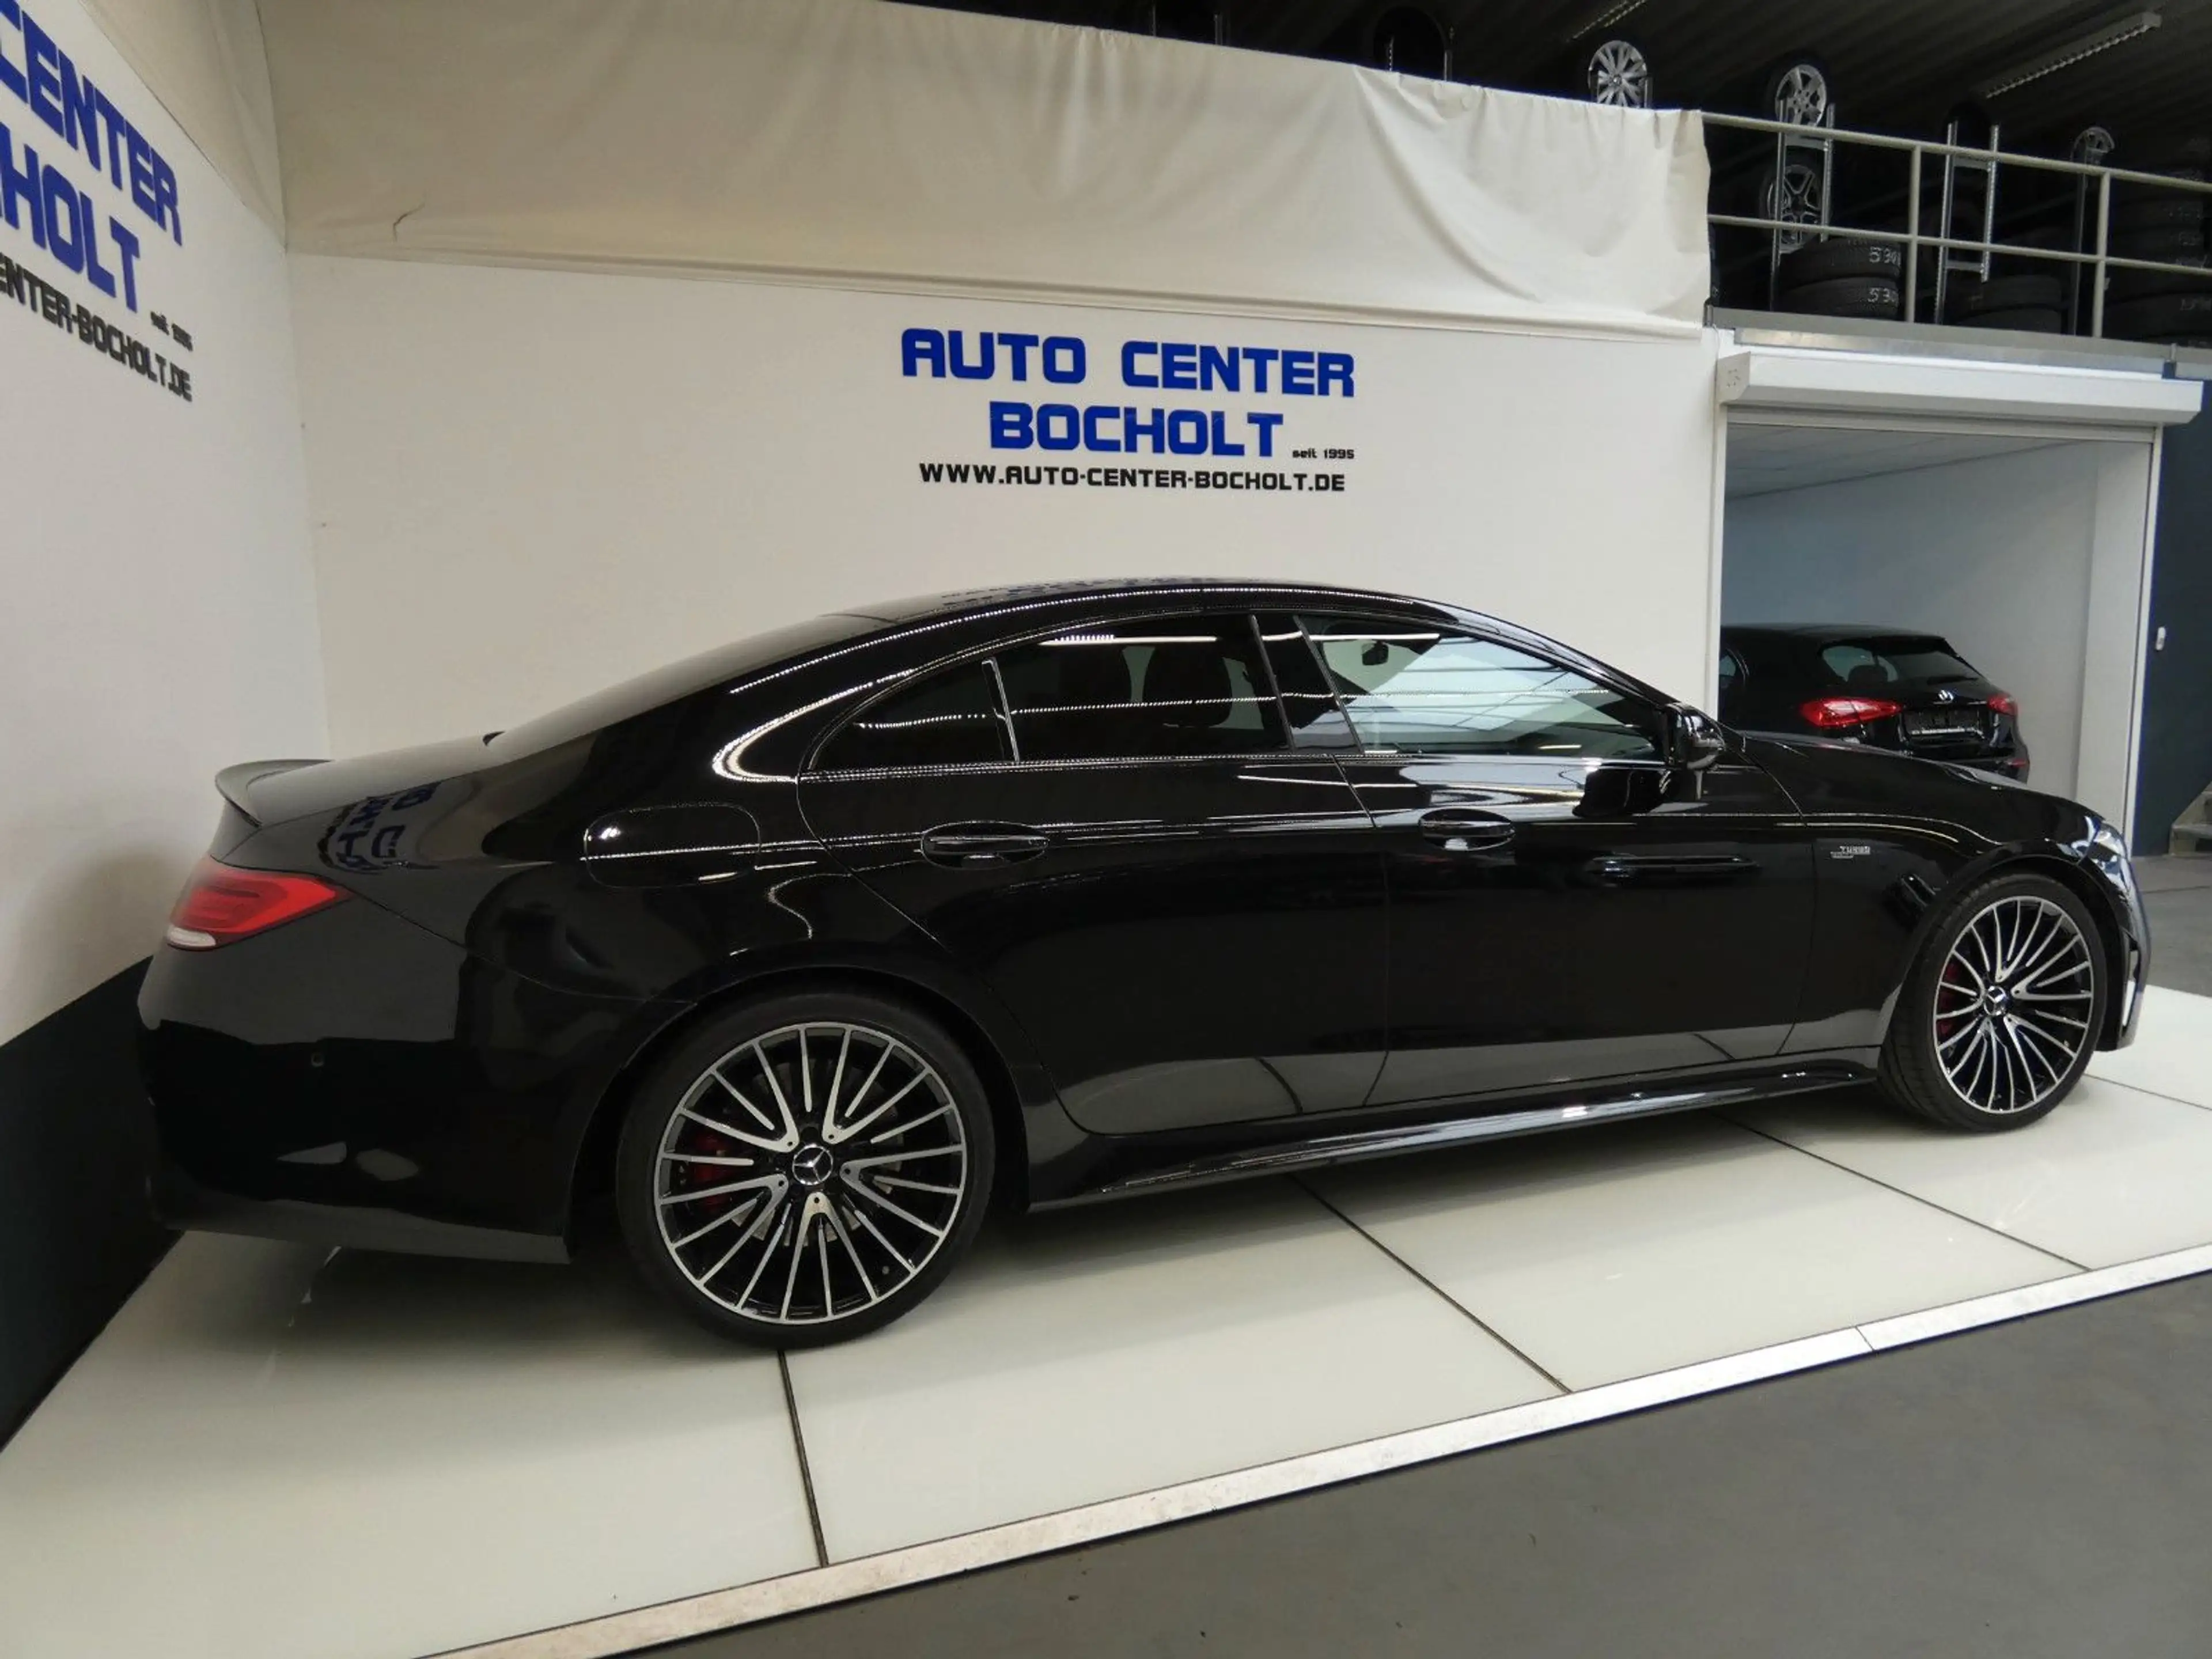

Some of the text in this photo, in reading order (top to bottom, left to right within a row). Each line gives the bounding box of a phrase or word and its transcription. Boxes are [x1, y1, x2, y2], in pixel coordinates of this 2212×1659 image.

[0, 121, 139, 313] HOLT
[902, 328, 1355, 397] AUTO CENTER
[989, 400, 1355, 460] BOCHOLT seit 1995
[919, 463, 1345, 492] WWW.AUTO-CENTER-BOCHOLT.DE
